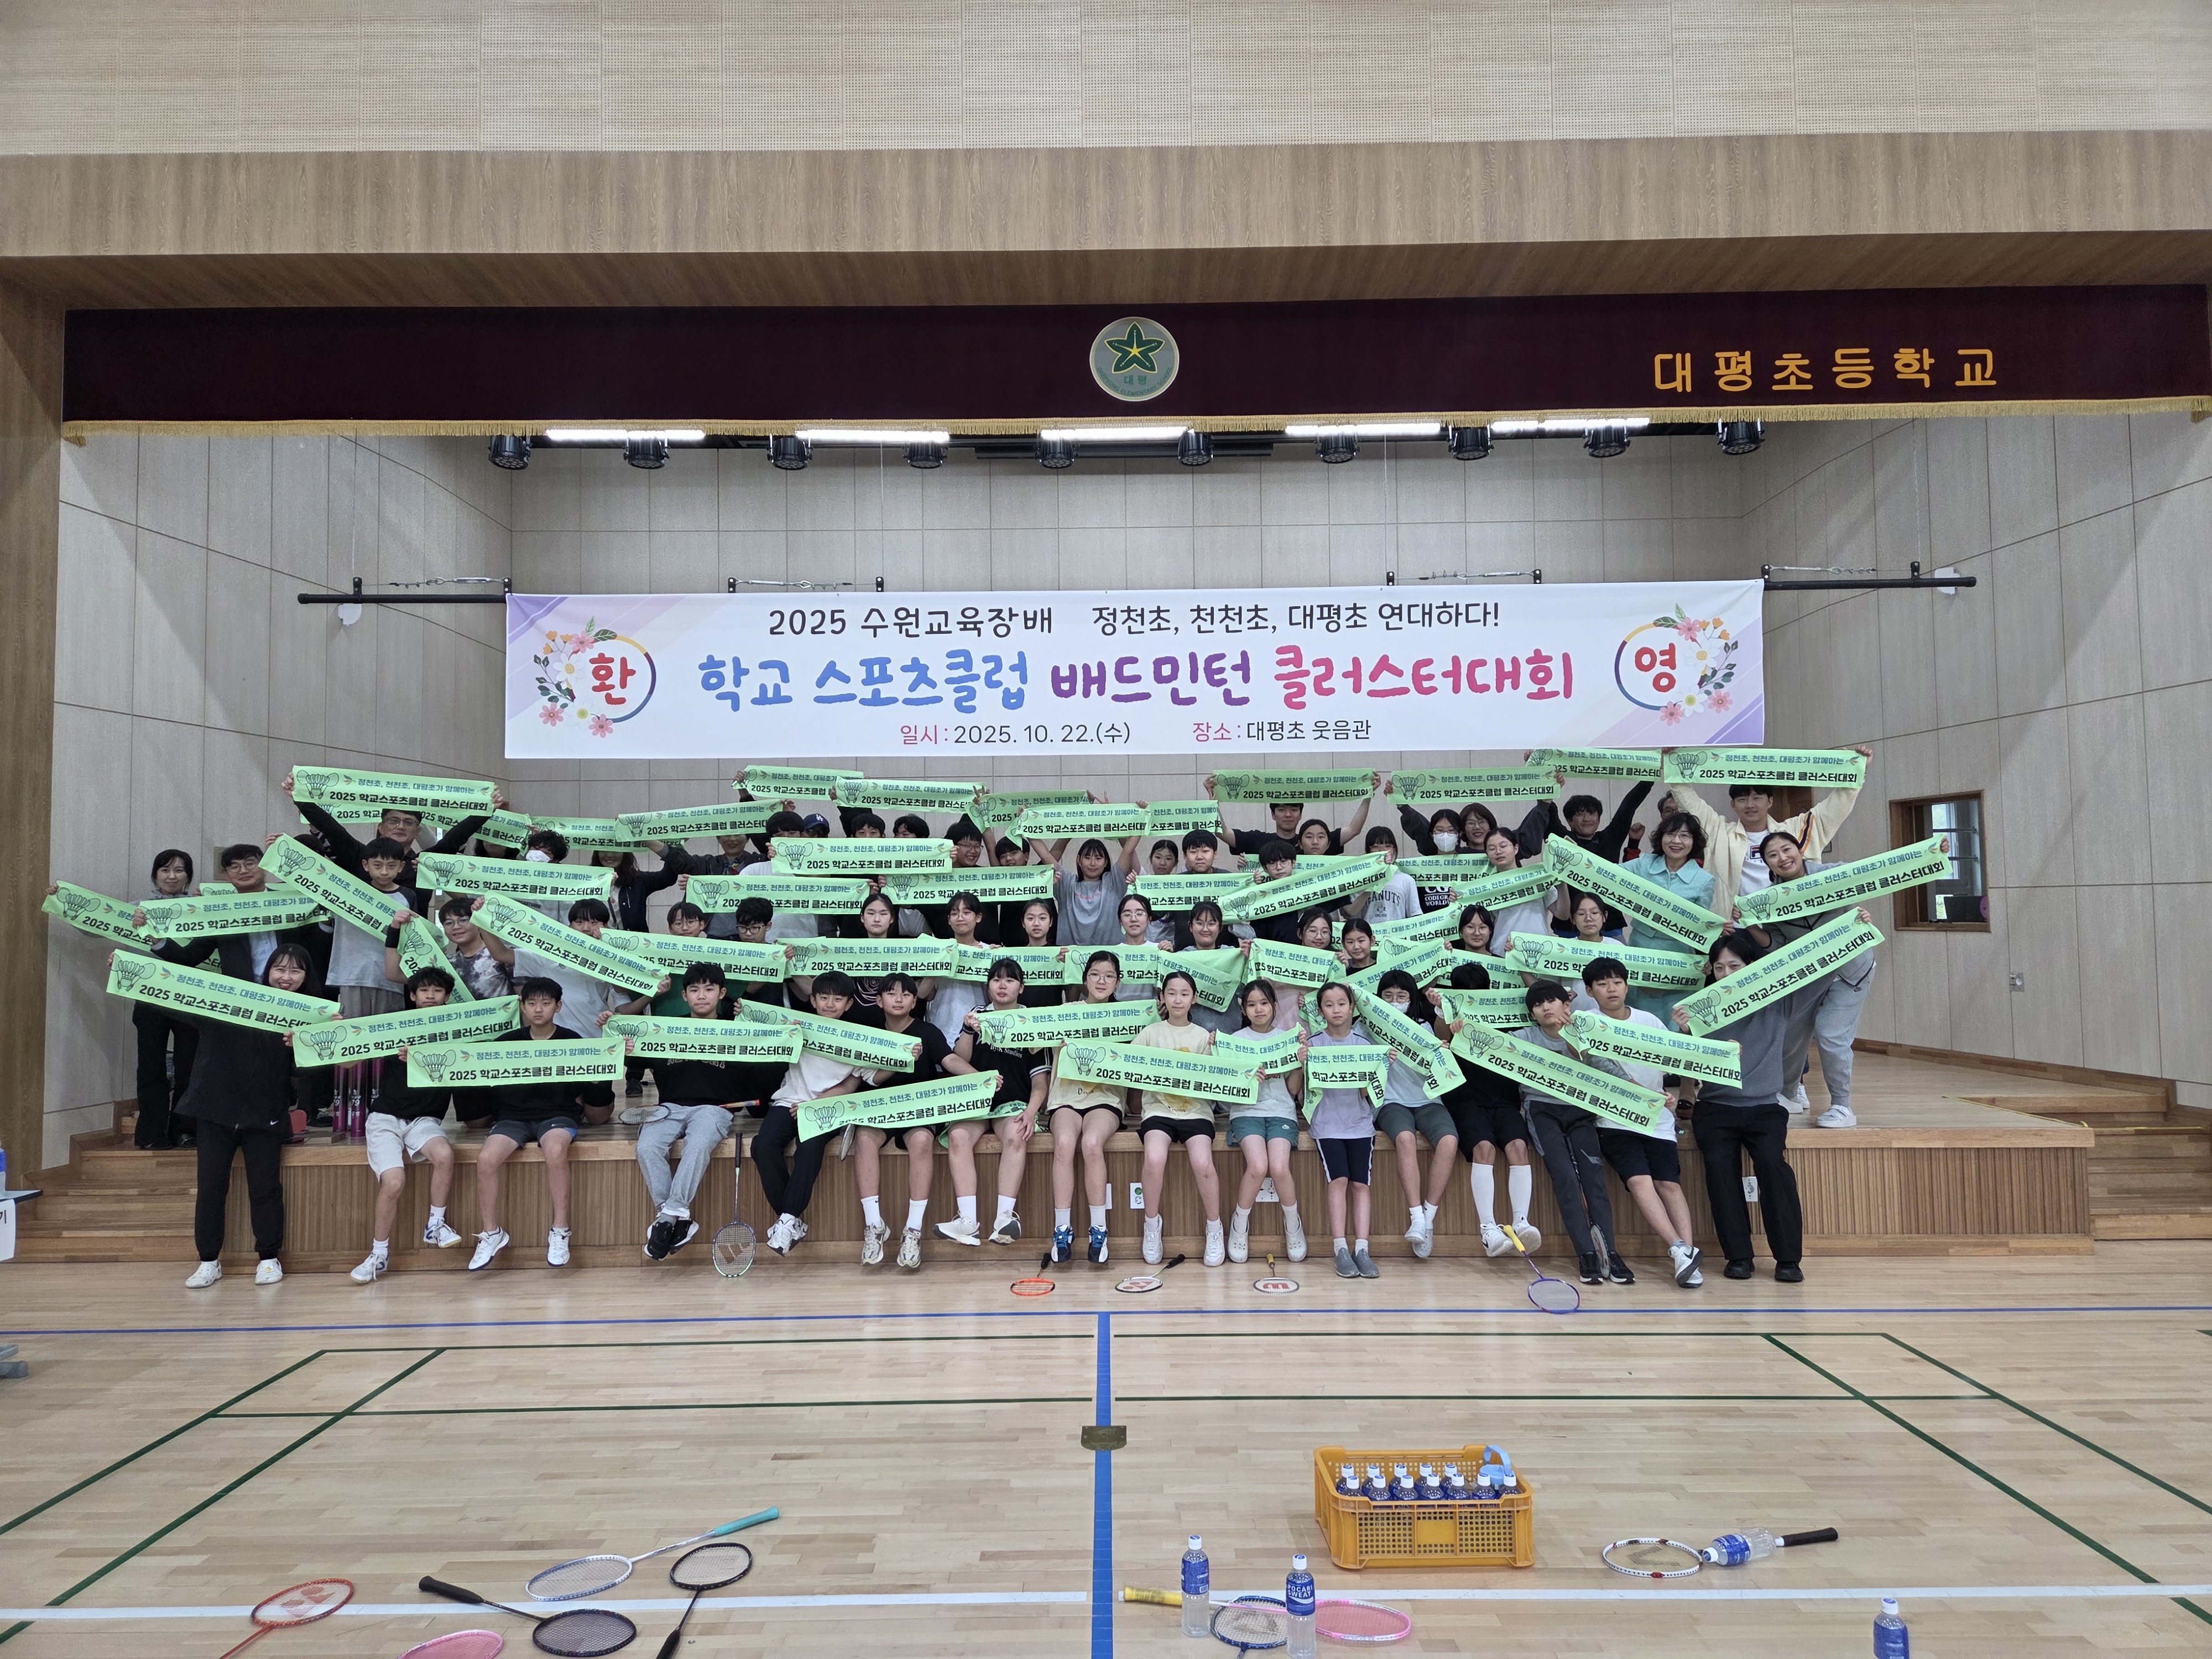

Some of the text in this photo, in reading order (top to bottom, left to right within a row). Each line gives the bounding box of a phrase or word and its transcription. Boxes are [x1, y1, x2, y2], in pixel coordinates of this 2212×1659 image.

[1120, 385, 1157, 396] ELEMENTARY
[1157, 366, 1172, 387] SCHOOL
[1655, 348, 1996, 392] 대평초등학교
[770, 601, 1498, 638] 2025 수원교육장배 정천초, 천천초, 대평초 연대하다!
[591, 654, 634, 703] 환
[698, 645, 1573, 713] 학교 스포츠클럽 배드민턴 클러스터대회
[1636, 644, 1675, 691] 영
[954, 726, 1016, 743] 2025.
[1024, 725, 1053, 742] 10.
[1062, 722, 1129, 744] 22.(수)
[1248, 721, 1305, 740] 대평초
[1312, 720, 1371, 740] 웃음관
[1752, 755, 1777, 763] 천천초,
[1779, 755, 1811, 764] 대평초가
[1813, 757, 1844, 765] 함께하는
[358, 778, 474, 794] 정천초, 천천초, 대평초가 함께하는
[1699, 769, 1857, 782] 2025 학교스포츠클럽 클러스터대회
[330, 791, 488, 811] 2025 학교스포츠클럽 클러스터대회
[1243, 788, 1368, 799] 2025 학교스포츠클럽 클러스터대회
[1420, 785, 1553, 799] 2025 학교스포츠클럽 클러스터대회
[482, 865, 592, 881] 정천초, 천천초, 대평초가 함께하는
[807, 858, 945, 869] 2025 학교스포츠클럽 클러스터대회
[1796, 850, 1922, 891] 정천초, 천천초, 대평초가 함께하는
[455, 878, 603, 895] 2025 학교스포츠클럽 클러스터대회
[1271, 862, 1371, 895] 정천초, 천천초, 대평초가 함께하는
[1775, 860, 1944, 916] 2025 학교스포츠클럽 클러스터대회
[1253, 870, 1386, 915] 2025 학교스포츠클럽 클러스터대회
[1595, 866, 1700, 924] 정천초, 천천초, 대평초가 함께하는
[1567, 870, 1707, 946] 2025 학교스포츠클럽 클러스터대회
[507, 927, 653, 990] 2025 학교스포츠클럽 클러스터대회
[540, 922, 646, 972] 정천초, 천천초, 대평초가 함께하는
[833, 946, 857, 954] 정천초,
[1735, 925, 1851, 988] 정천초, 천천초, 대평초가 함께하는
[812, 961, 952, 972] 2025 학교스포츠클럽 클러스터대회
[1721, 931, 1875, 1017] 2025 학교스포츠클럽 클러스터대회
[367, 1007, 496, 1033] 정천초, 천천초, 대평초가 함께하는
[666, 1026, 782, 1037] 정천초, 천천초, 대평초가 함께하는
[341, 1020, 513, 1056] 2025 학교스포츠클럽 클러스터대회
[640, 1042, 793, 1056] 2025 학교스포츠클럽 클러스터대회
[476, 1047, 601, 1060] 정천초, 천천초, 대평초가 함께하는
[1004, 1048, 1022, 1058] Studios
[1123, 1053, 1238, 1077] 정천초, 천천초, 대평초가 함께하는
[449, 1063, 616, 1081] 2025 학교스포츠클럽 클러스터대회
[1095, 1067, 1250, 1098] 2025 학교스포츠클럽 클러스터대회
[1528, 1053, 1642, 1103] 정천초, 천천초, 대평초가 함께하는
[1488, 1054, 1650, 1126] 2025 학교스포츠클럽 클러스터대회
[1288, 1584, 1313, 1593] POCARI
[1288, 1589, 1311, 1598] SWEAT
